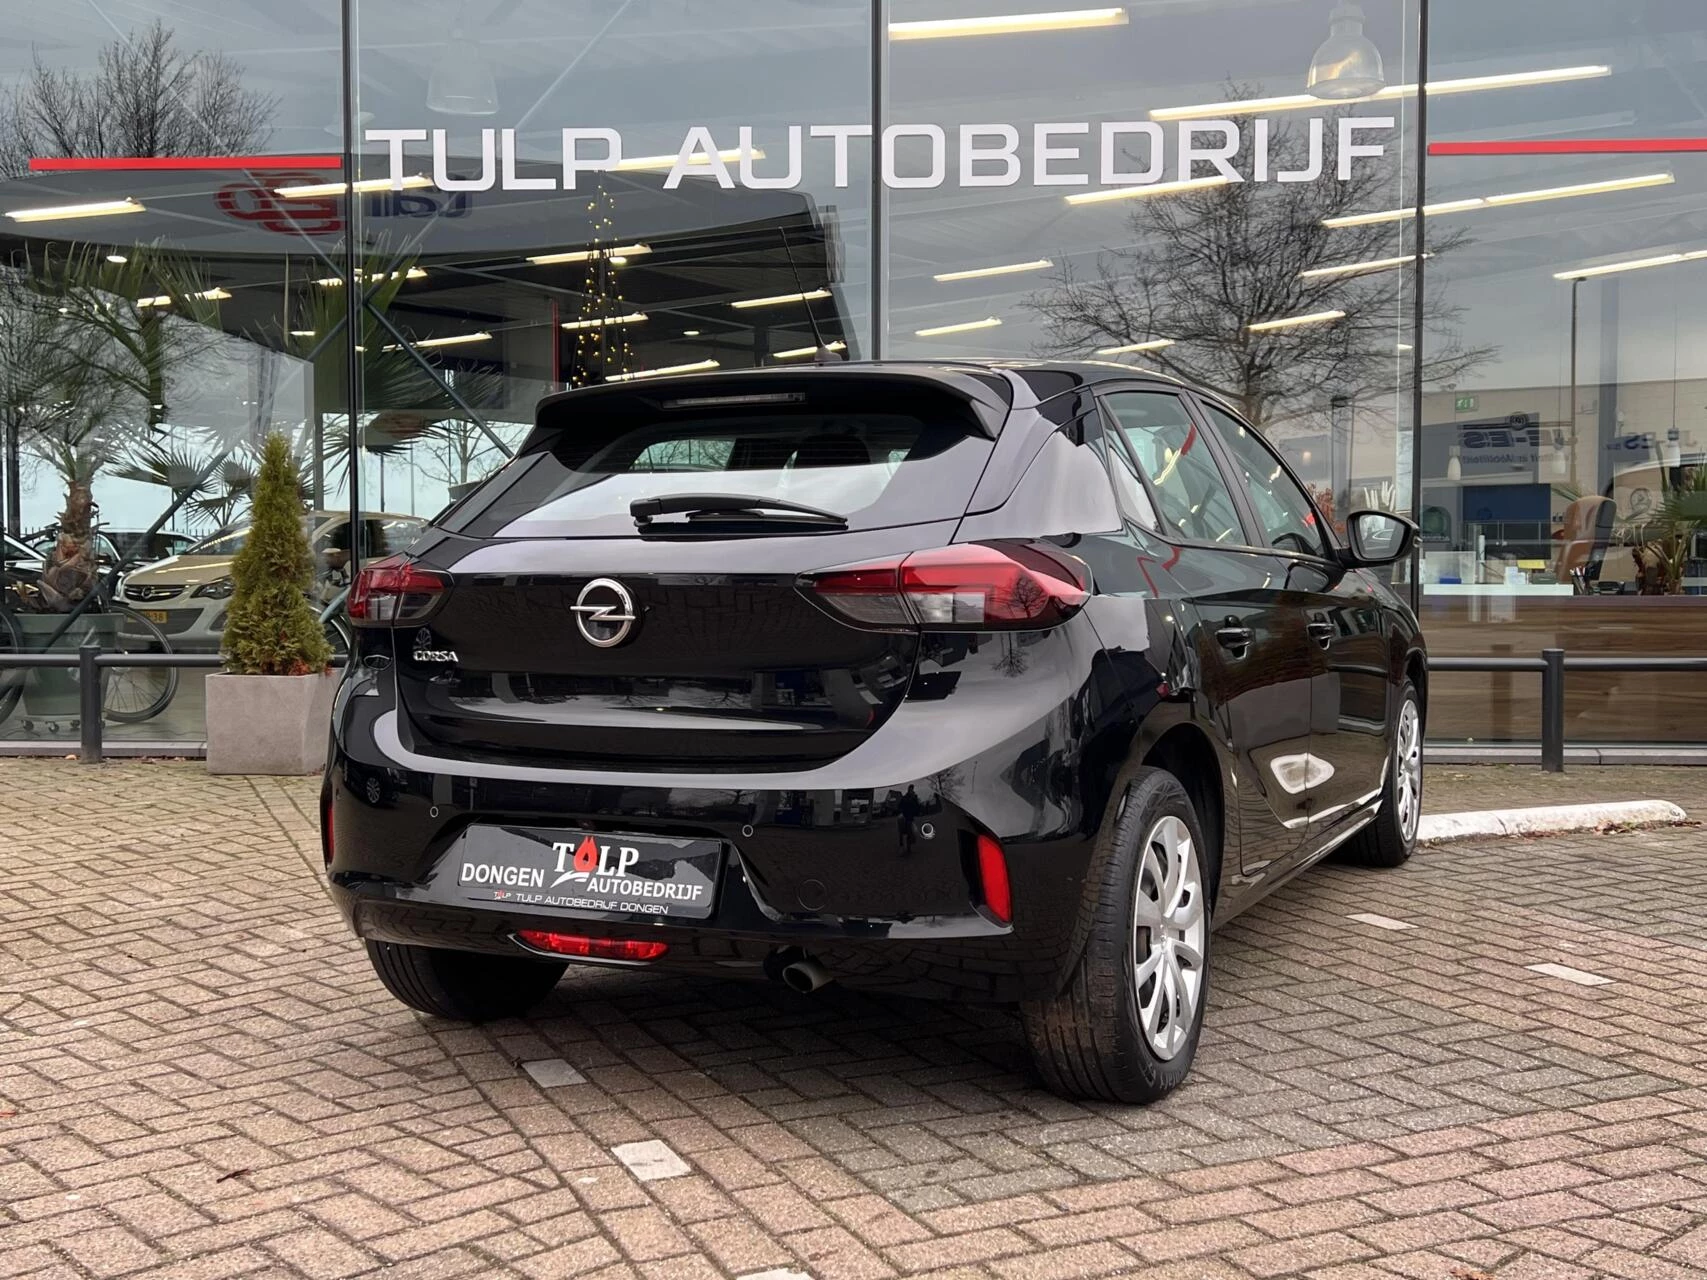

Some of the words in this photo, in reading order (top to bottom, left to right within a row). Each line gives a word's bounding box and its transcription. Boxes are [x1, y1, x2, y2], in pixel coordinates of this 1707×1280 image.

[364, 127, 623, 192] TULP
[662, 116, 1396, 190] AUTOBEDRIJF
[413, 650, 459, 663] CORSA
[461, 862, 545, 888] DONGEN
[586, 877, 703, 901] AUTOBEDRIJF
[515, 892, 543, 904] TULP
[543, 894, 618, 910] AUTOBEDRIJF
[619, 901, 669, 915] DONGEN
